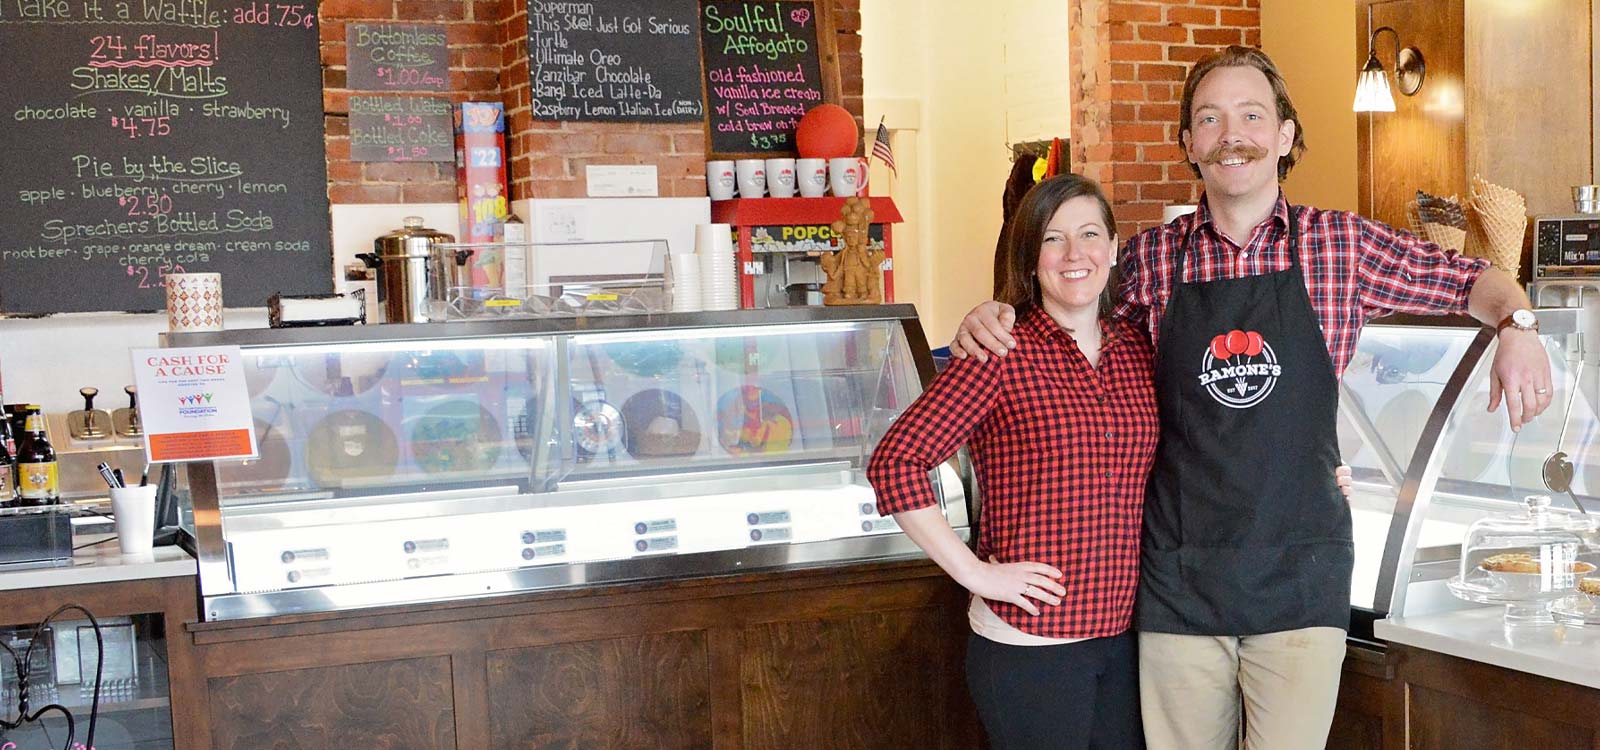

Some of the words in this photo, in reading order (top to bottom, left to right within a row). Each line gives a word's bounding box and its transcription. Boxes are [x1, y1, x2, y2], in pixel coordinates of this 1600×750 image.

[84, 0, 104, 20] it
[116, 3, 130, 19] a
[143, 0, 228, 24] Waffle:
[233, 3, 269, 24] add
[534, 0, 594, 18] Superman
[705, 3, 784, 33] Soulful
[533, 14, 560, 31] This
[596, 17, 619, 33] Just
[623, 16, 642, 34] Got
[649, 16, 690, 35] Serious
[90, 36, 127, 59] 24
[134, 31, 219, 60] flavors!
[354, 24, 447, 47] Bottomless
[533, 30, 568, 49] Turtle
[370, 46, 431, 64] Coffee
[723, 33, 808, 60] Affogato
[536, 48, 585, 66] Ultimate
[590, 49, 621, 66] Oreo
[376, 67, 444, 87] $1.00/cup
[535, 65, 587, 83] Zanzibar
[595, 66, 652, 84] Chocolate
[736, 64, 805, 83] fashioned
[536, 81, 566, 101] Bang!
[572, 84, 603, 99] Iced
[610, 84, 662, 99] Latte-Da
[761, 87, 780, 99] ice
[784, 88, 821, 100] cream
[14, 103, 97, 121] chocolate
[124, 100, 179, 117] vanilla
[203, 101, 290, 128] strawberry
[350, 96, 403, 113] Bottled
[409, 96, 452, 114] Water
[585, 101, 616, 116] Lemon
[618, 102, 652, 116] Italian
[655, 103, 672, 116] Ice
[716, 101, 729, 117] w/
[735, 103, 759, 117] Soul
[760, 103, 805, 116] Brewed
[111, 116, 170, 138] $4.75
[351, 126, 405, 145] Bottled
[407, 124, 449, 146] Coke
[718, 120, 743, 132] cold
[745, 119, 772, 132] brew
[751, 133, 786, 149] $3.75
[72, 155, 113, 177] Pie
[124, 156, 144, 182] by
[150, 156, 186, 174] the
[190, 156, 242, 176] Slice
[19, 187, 65, 204] apple
[82, 184, 159, 199] blueberry
[172, 181, 224, 198] cherry
[237, 179, 287, 194] lemon
[119, 194, 173, 216] $2.50
[41, 220, 149, 244] Sprechers
[156, 213, 218, 232] Bottled
[226, 209, 274, 228] Soda
[782, 226, 842, 240] POPC
[3, 247, 35, 261] root
[39, 246, 71, 258] beer
[82, 244, 119, 262] grape
[128, 241, 171, 258] orange
[173, 240, 216, 251] dream
[225, 241, 270, 252] cream
[274, 240, 311, 251] soda
[118, 252, 173, 271] cherry
[176, 252, 210, 263] cola
[147, 356, 192, 367] CASH
[198, 354, 230, 364] FOR
[155, 367, 168, 377] A
[171, 365, 226, 376] CAUSE
[1198, 364, 1281, 385] RAMONE'S
